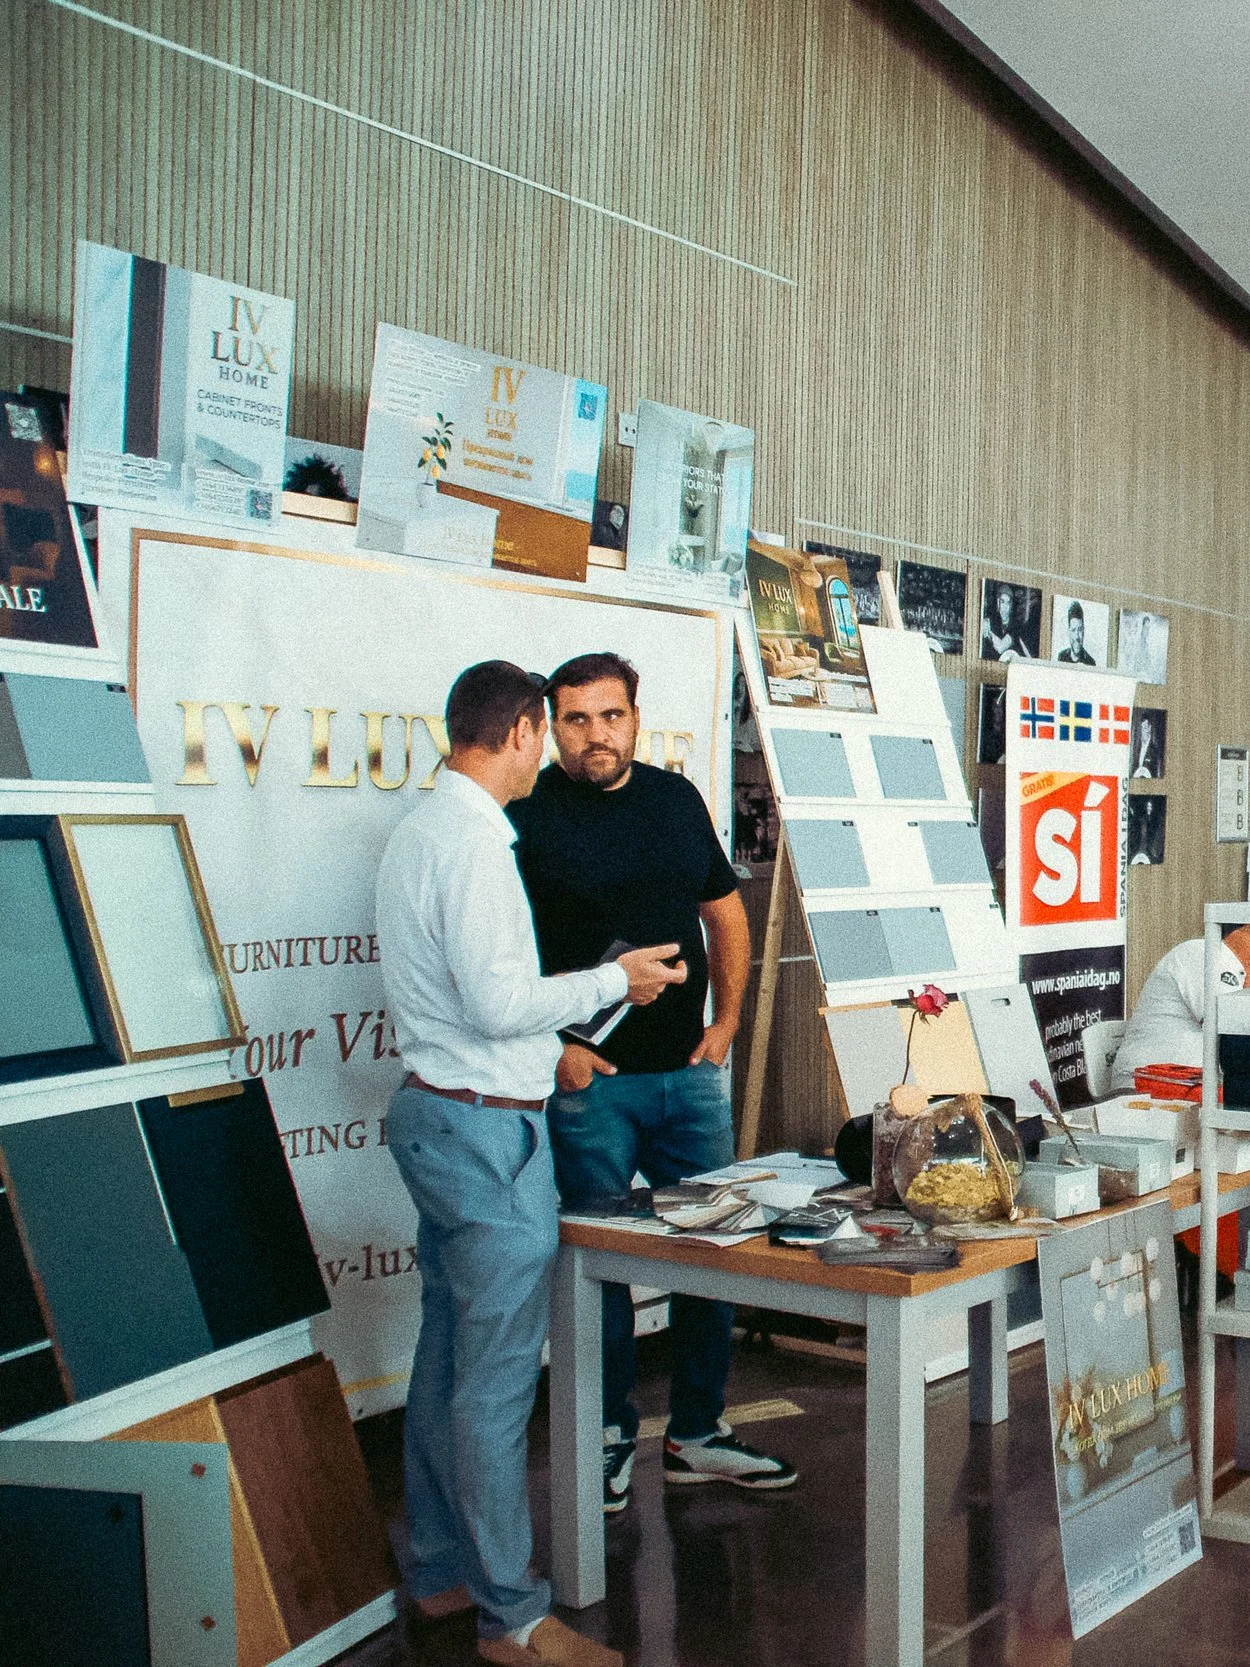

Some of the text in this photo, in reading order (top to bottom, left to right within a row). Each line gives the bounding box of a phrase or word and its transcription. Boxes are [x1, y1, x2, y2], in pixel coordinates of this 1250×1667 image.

[228, 295, 270, 335] IV
[210, 330, 278, 375] LUX
[219, 366, 269, 390] HOME
[491, 365, 526, 405] IV
[197, 389, 283, 417] CABINET FRONTS
[207, 405, 281, 429] COUNTERTOPS
[485, 406, 517, 430] LUX
[758, 578, 793, 604] IV LUX
[768, 602, 790, 615] HOME
[175, 699, 280, 787] IV
[1121, 777, 1129, 822] DAG
[1119, 840, 1127, 918] SPANIA
[223, 934, 382, 974] URNITURE
[1031, 968, 1121, 995] www.spaniaidag.no
[1044, 1008, 1102, 1044] probably the best
[228, 1025, 317, 1078] our
[1058, 1064, 1076, 1083] Costa
[1076, 1058, 1087, 1077] Bl
[316, 1244, 420, 1288] v-lux
[1068, 1398, 1086, 1430] IV
[1091, 1381, 1122, 1419] LUX
[1126, 1361, 1168, 1401] HOME
